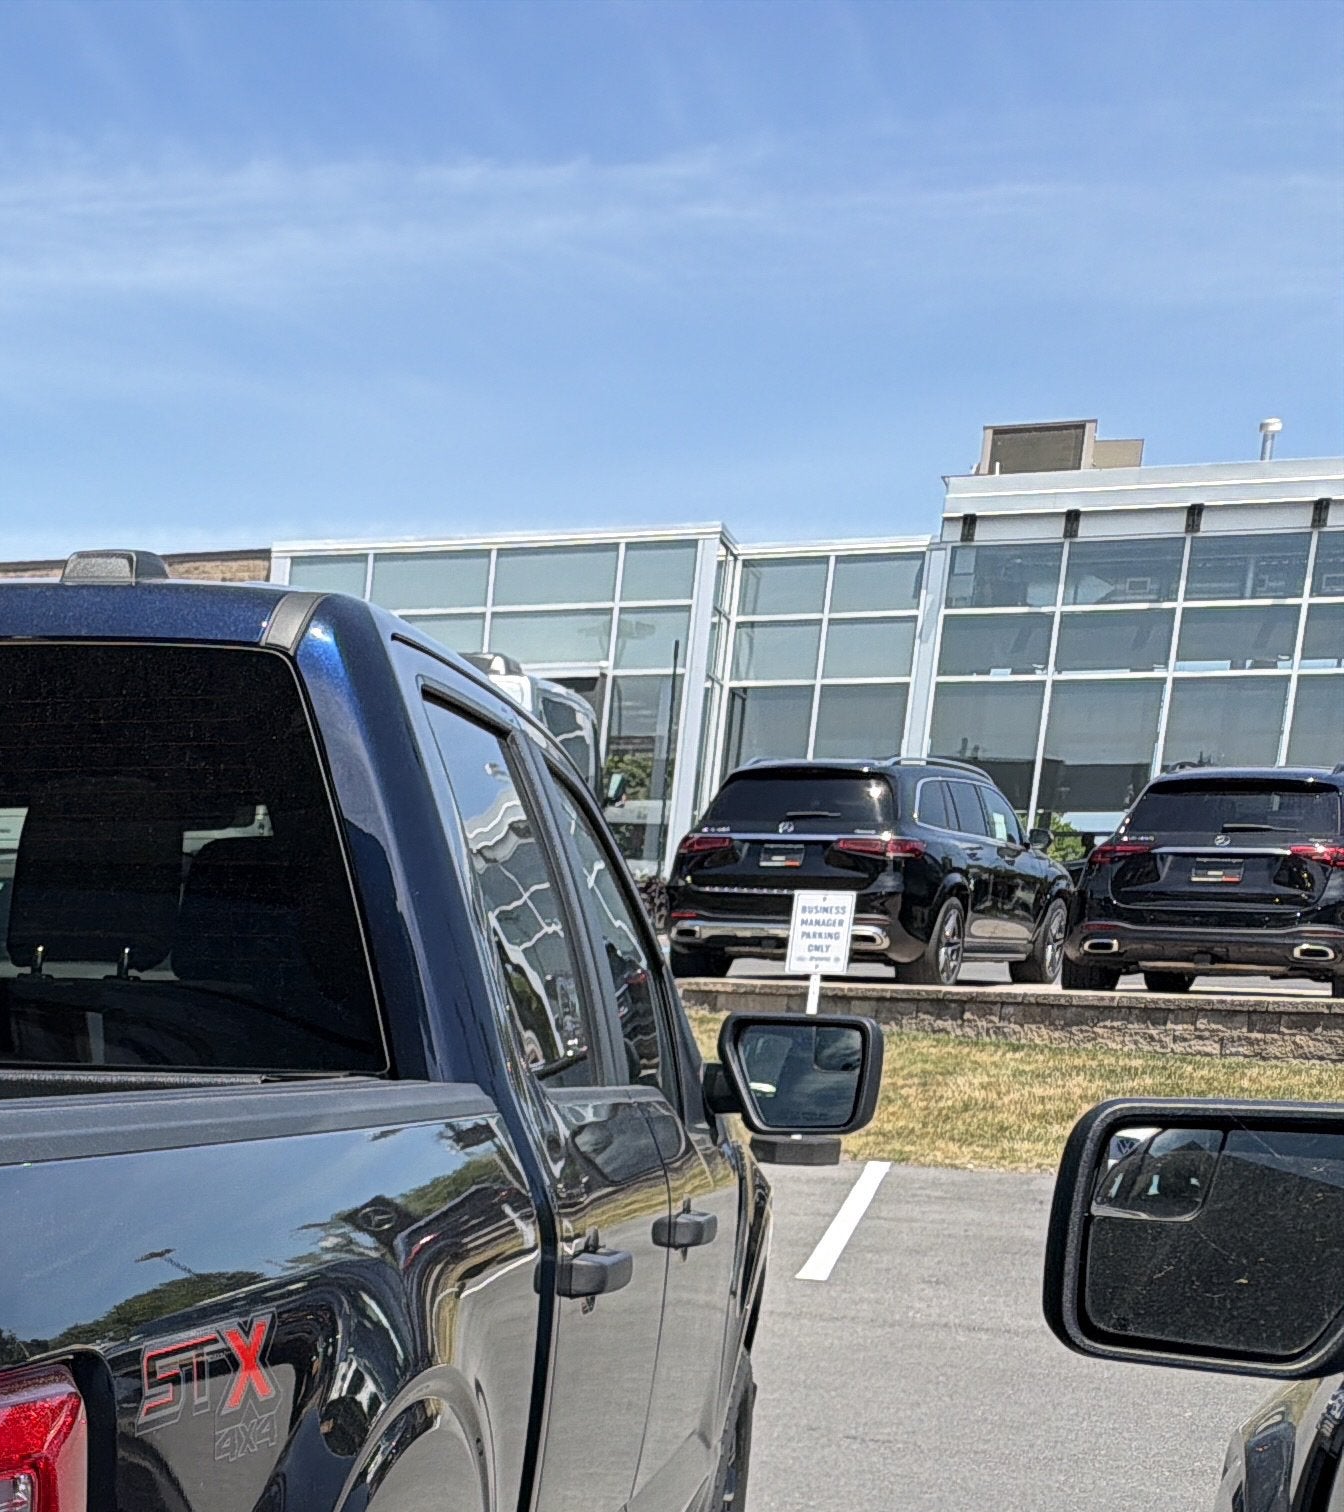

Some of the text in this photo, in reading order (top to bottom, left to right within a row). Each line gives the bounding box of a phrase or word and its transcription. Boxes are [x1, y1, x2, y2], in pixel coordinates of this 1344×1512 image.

[801, 905, 847, 915] BUSINESS
[800, 918, 845, 928] MANAGER
[800, 931, 841, 941] PARKING
[807, 943, 831, 953] ONLY
[135, 1308, 283, 1437] STX
